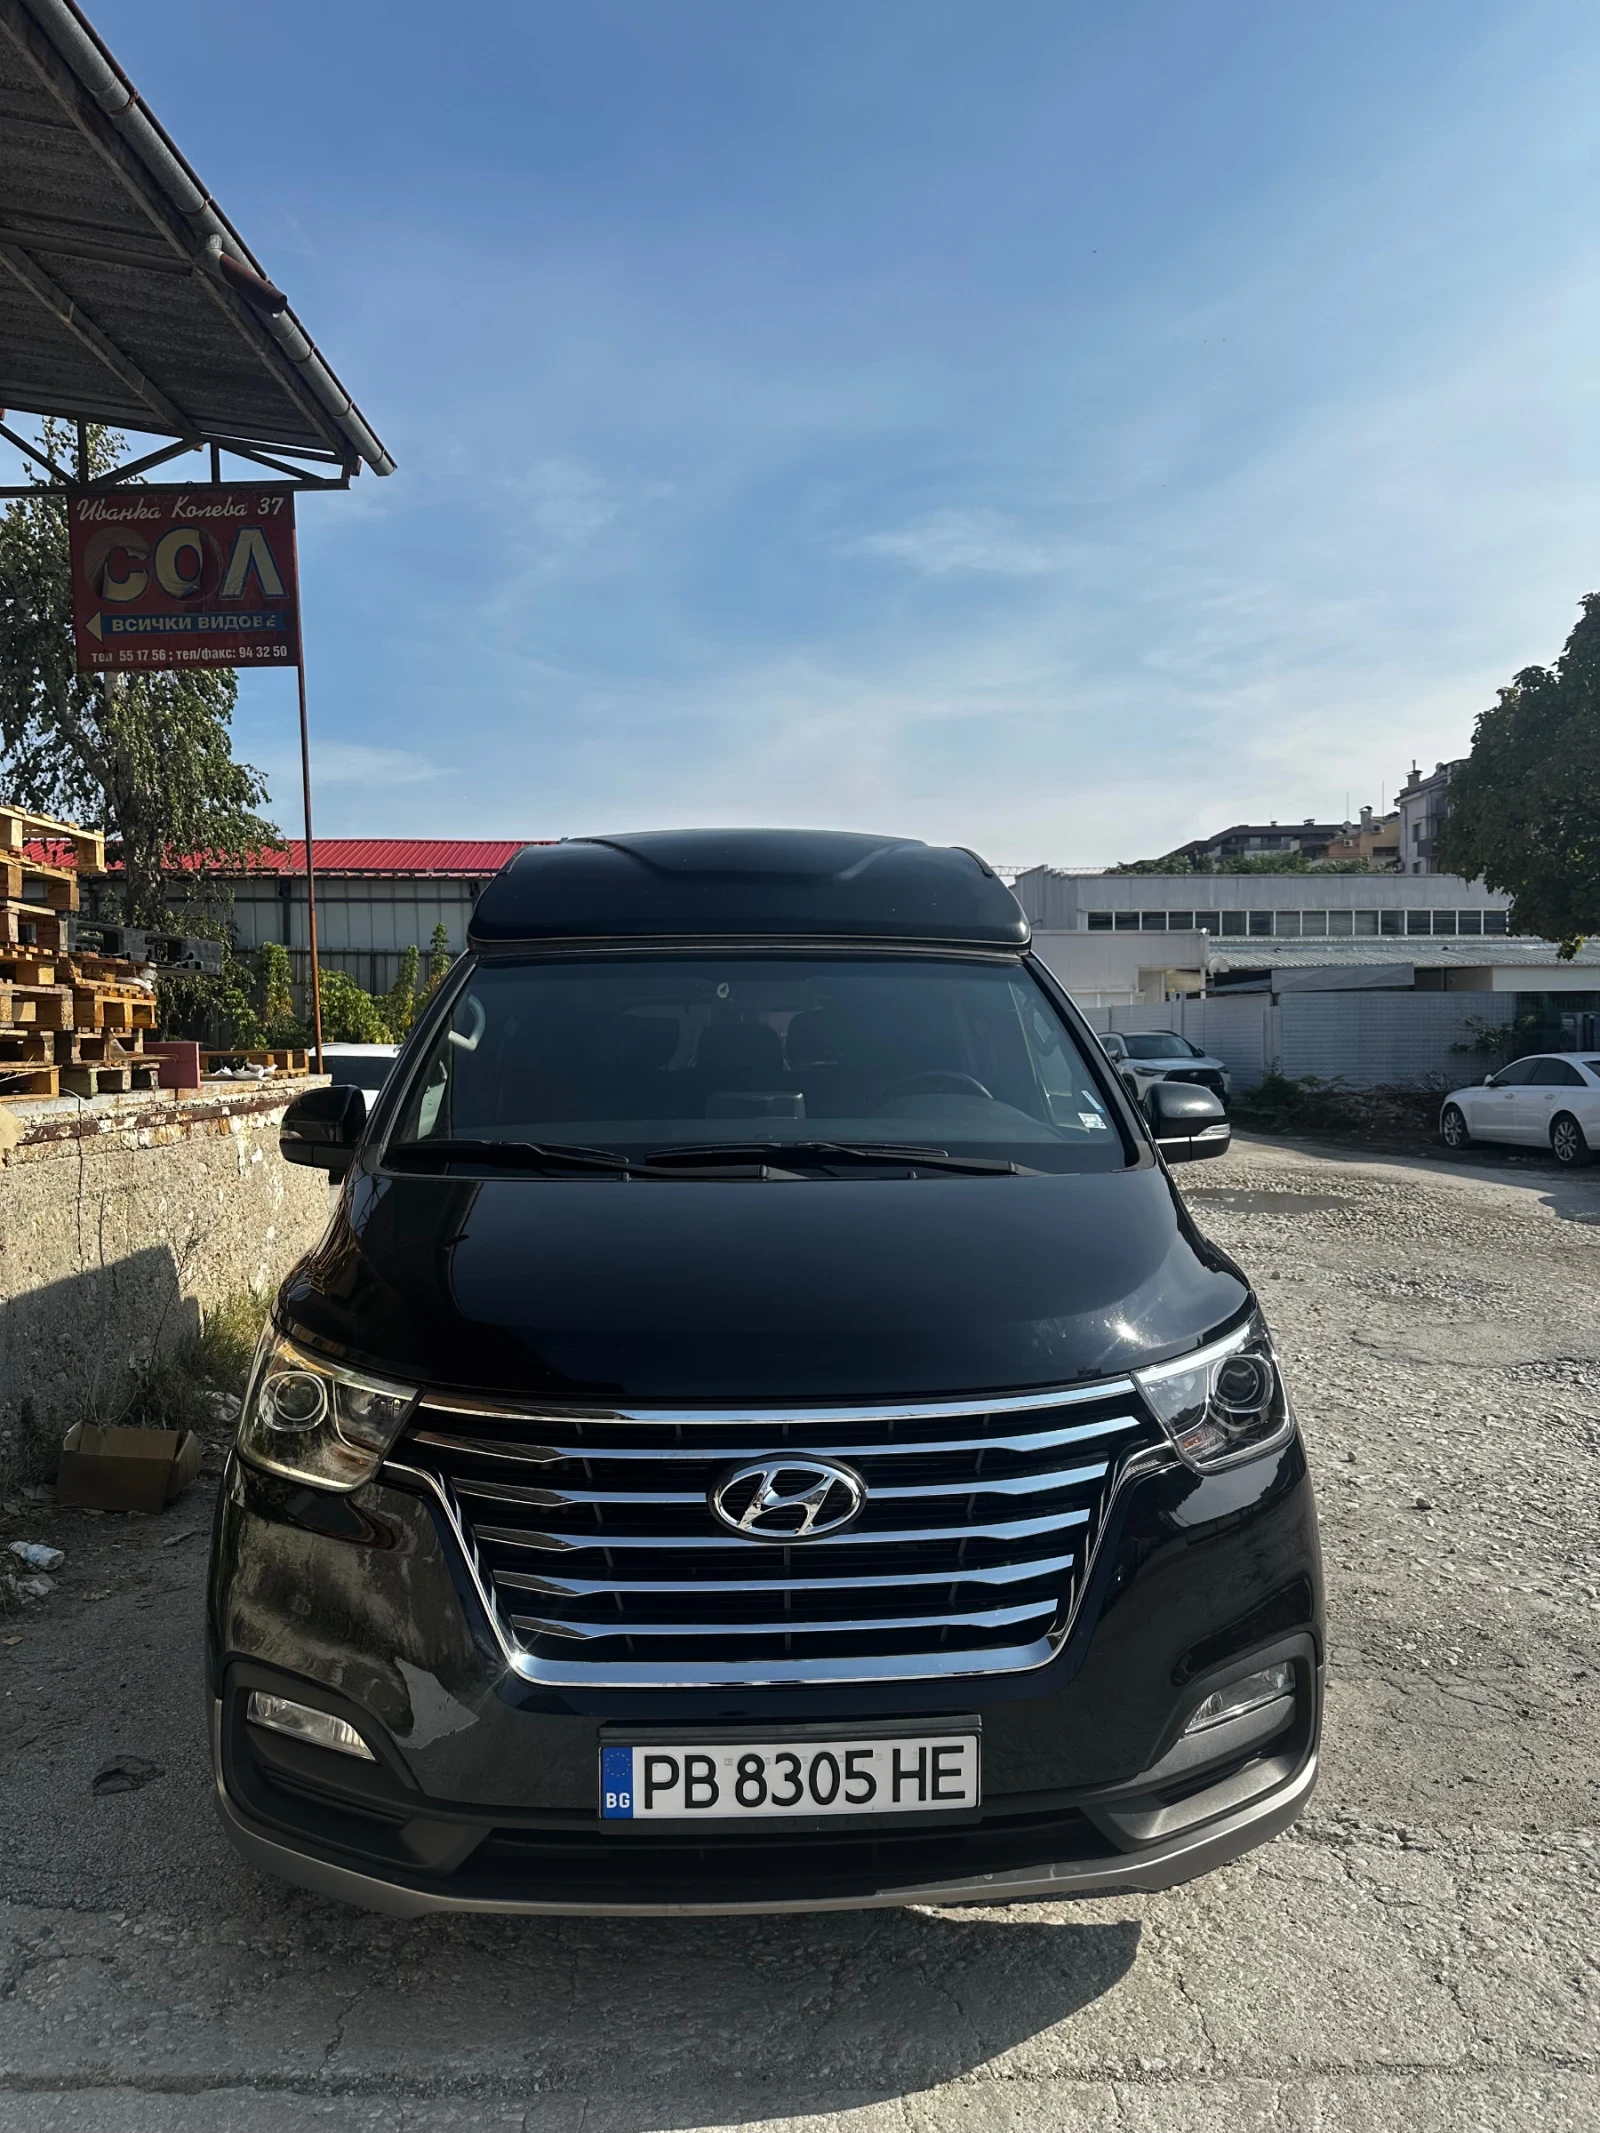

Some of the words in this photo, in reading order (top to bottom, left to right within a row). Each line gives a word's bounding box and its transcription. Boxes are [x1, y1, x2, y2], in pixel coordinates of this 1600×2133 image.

[77, 497, 162, 521] Иванка
[171, 495, 248, 518] Колева
[257, 497, 285, 516] 37
[84, 525, 290, 604] СОЛ
[112, 617, 191, 632] ВСИЧКИ
[119, 650, 134, 661] 55
[136, 649, 149, 661] 17
[151, 648, 167, 661] 56
[175, 647, 236, 660] тел/факс:
[239, 646, 253, 658] 94
[256, 646, 271, 657] 32
[273, 645, 288, 657] 50
[644, 1753, 720, 1809] PB
[734, 1750, 877, 1808] 8305
[892, 1745, 966, 1803] HE
[606, 1792, 631, 1809] BG
